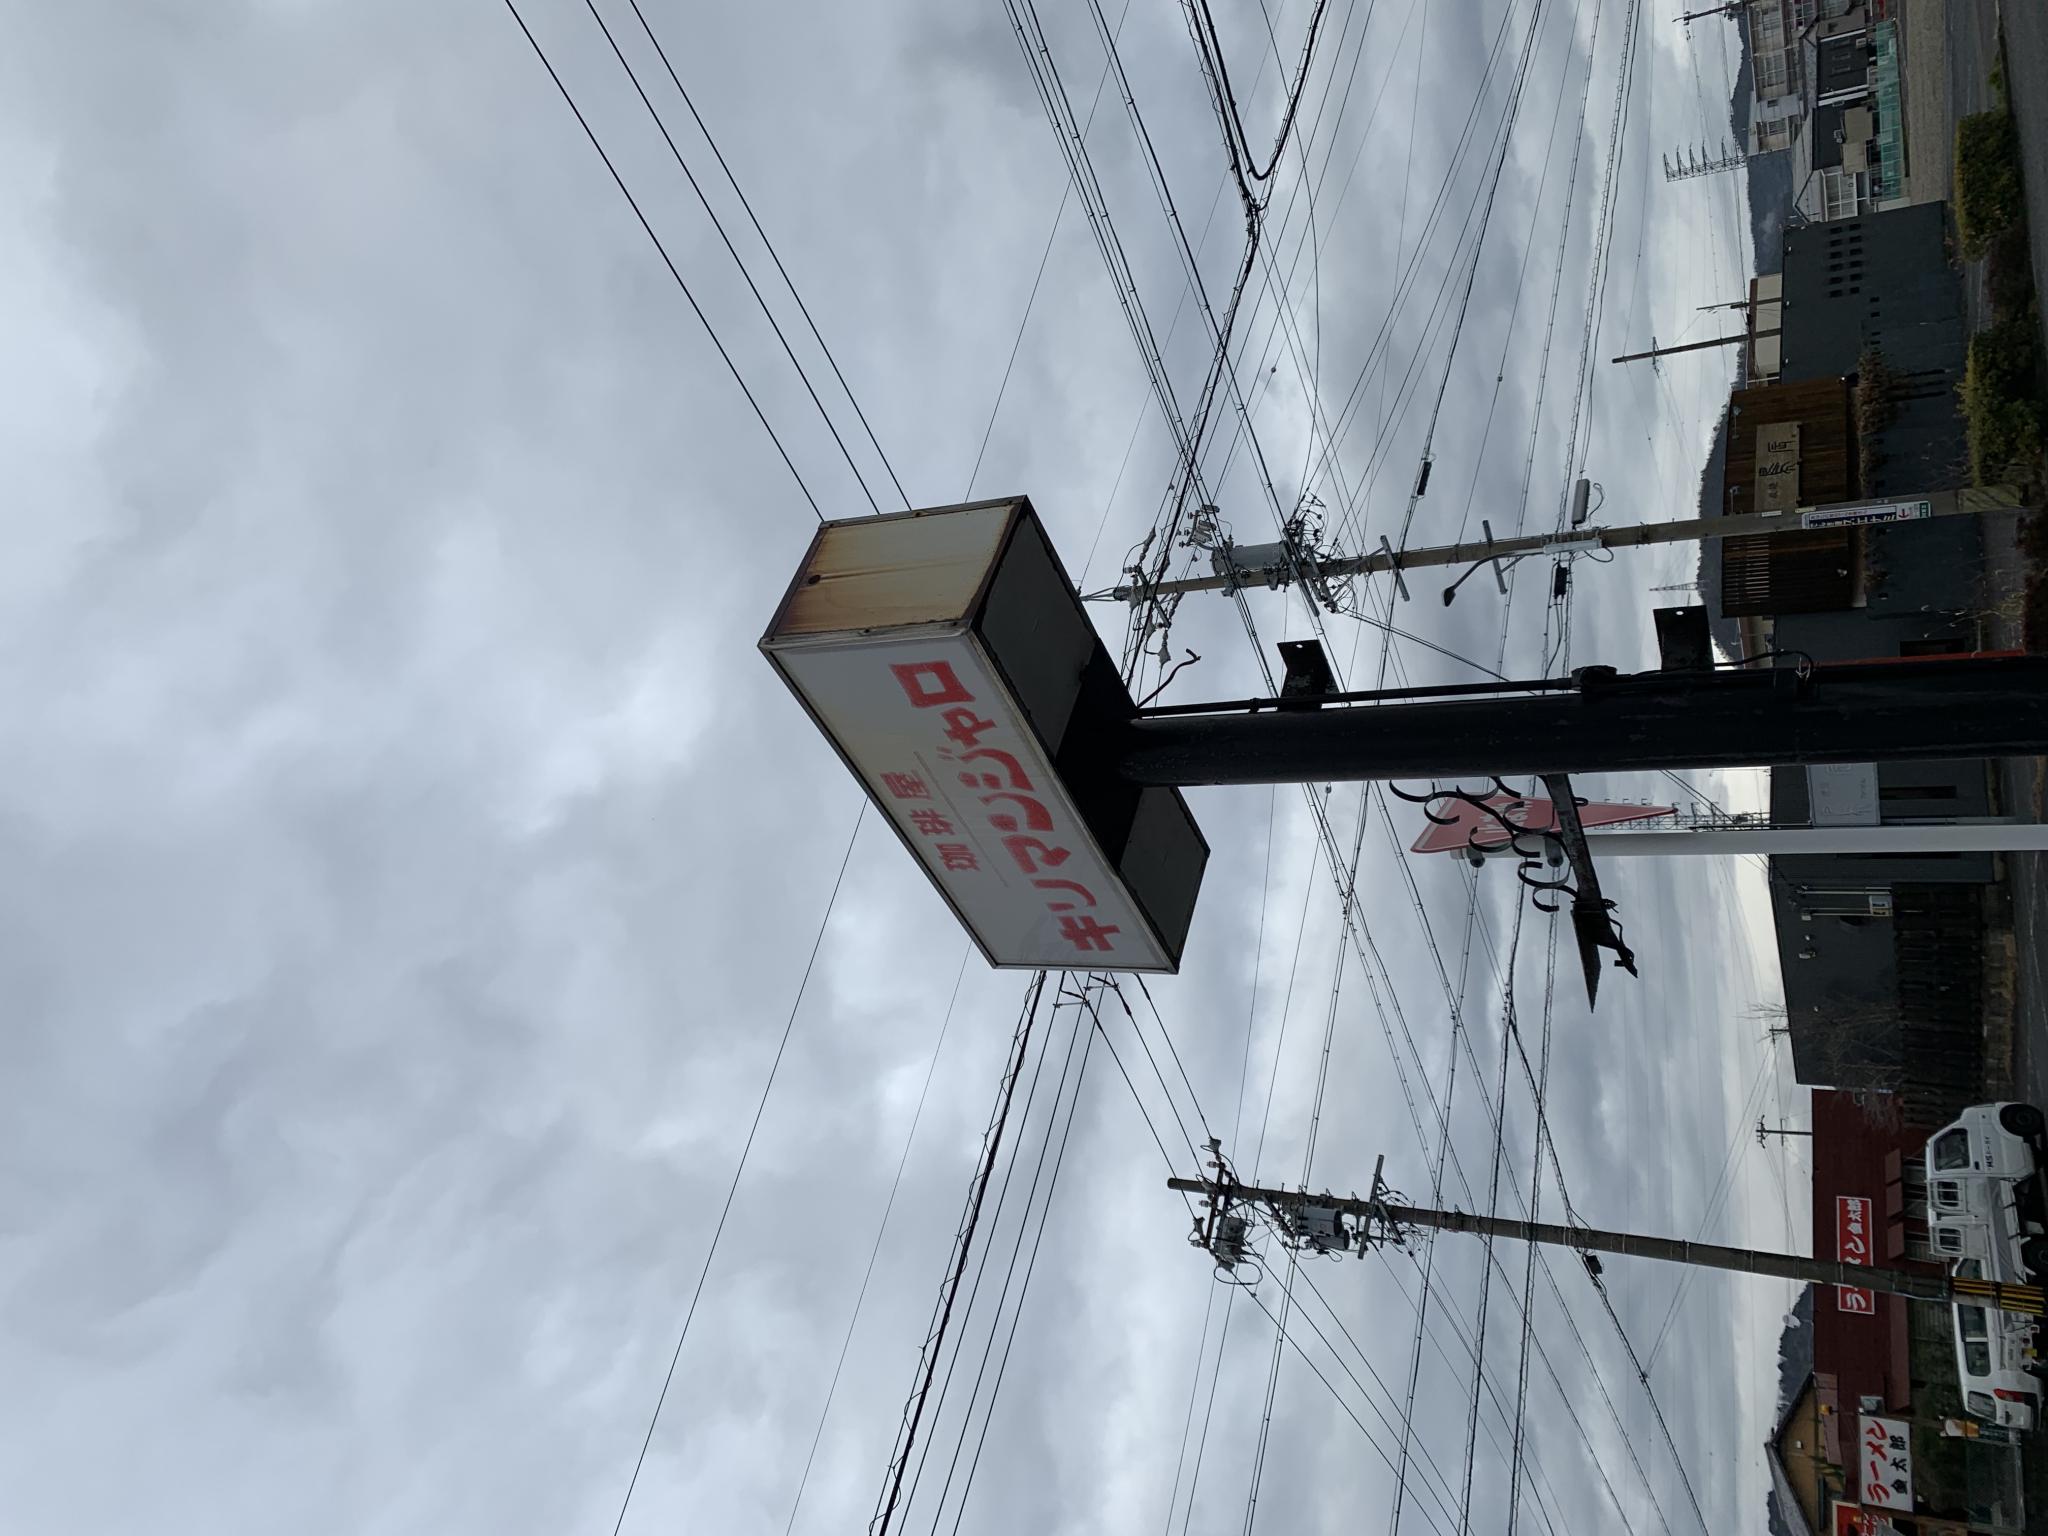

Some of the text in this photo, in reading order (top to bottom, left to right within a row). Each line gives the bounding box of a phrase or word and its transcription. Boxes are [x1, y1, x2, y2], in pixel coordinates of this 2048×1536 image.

[879, 771, 981, 872] 珈琲屋
[888, 660, 1122, 952] キリマンジャロ
[1866, 1419, 1890, 1504] ラーメン
[1889, 1435, 1908, 1495] 金太郎
